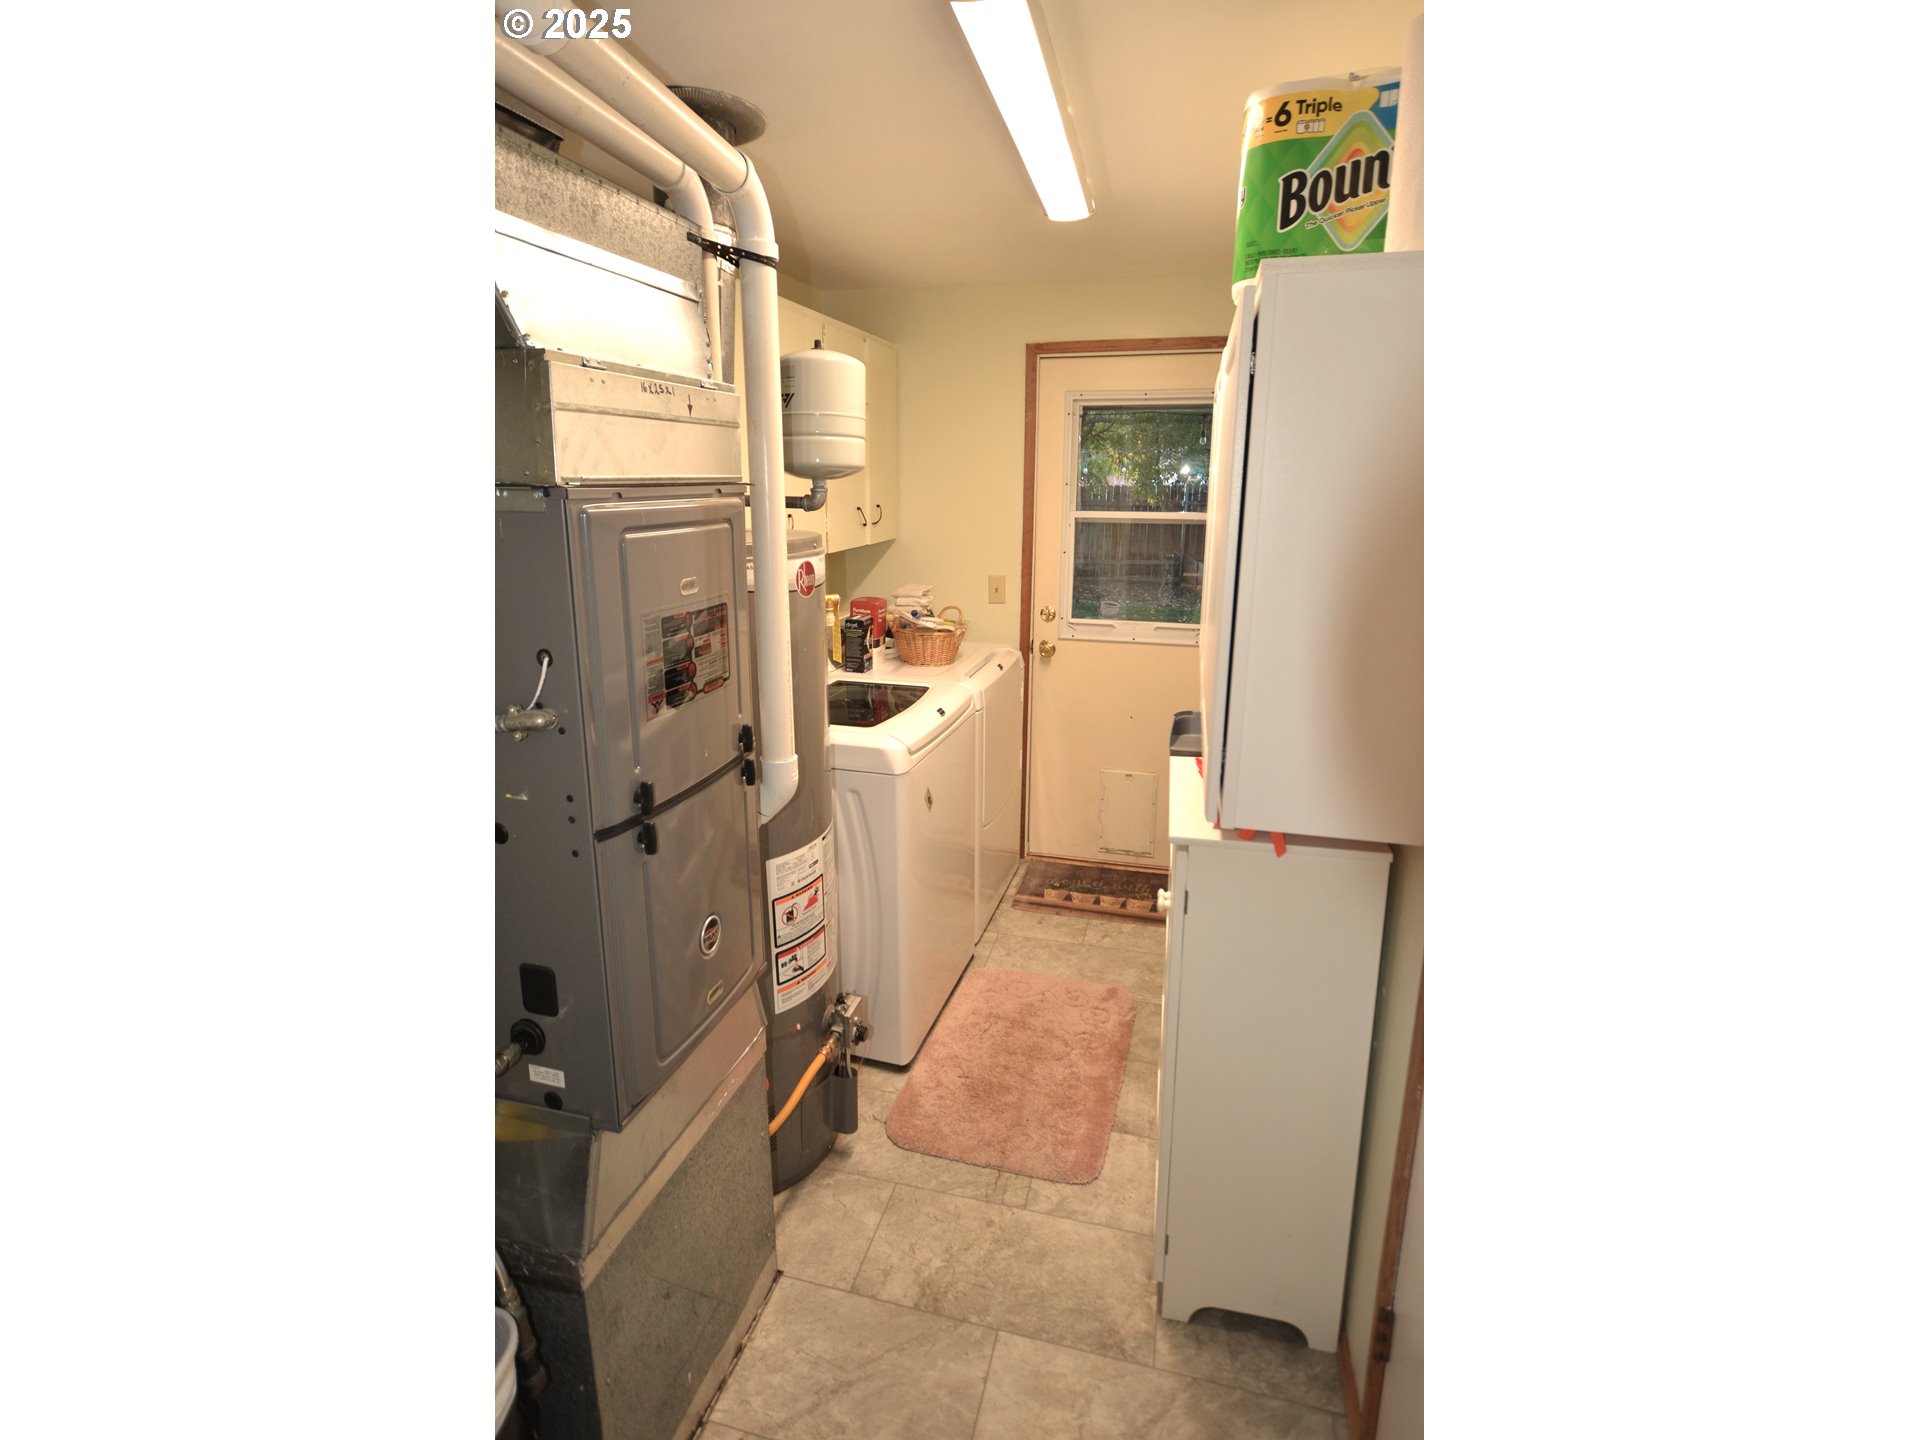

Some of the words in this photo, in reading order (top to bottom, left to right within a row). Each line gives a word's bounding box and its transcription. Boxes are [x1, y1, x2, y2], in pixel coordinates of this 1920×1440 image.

[1296, 97, 1342, 117] Triple
[1279, 148, 1395, 231] Boun
[1305, 220, 1317, 228] The
